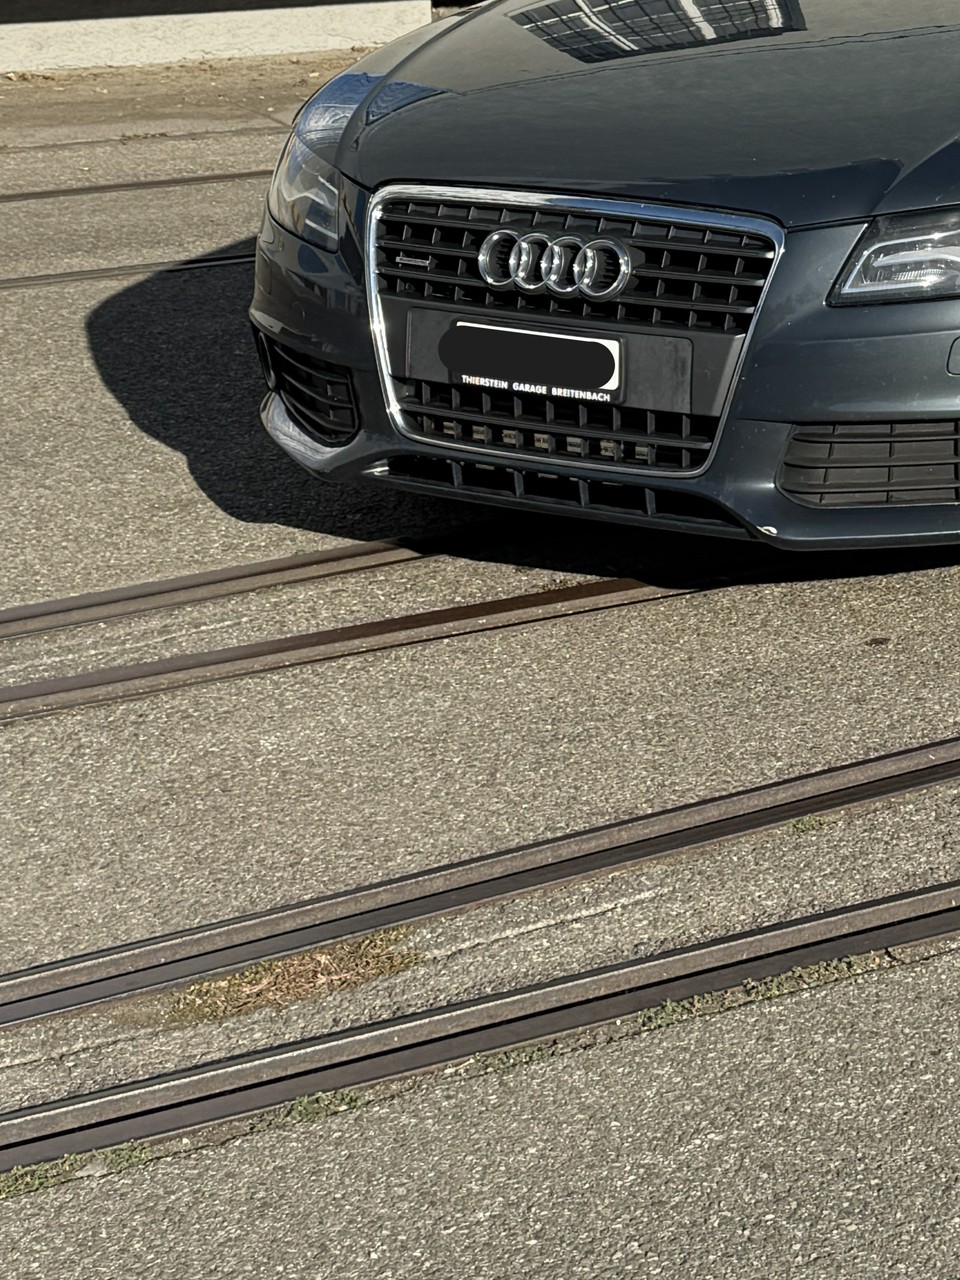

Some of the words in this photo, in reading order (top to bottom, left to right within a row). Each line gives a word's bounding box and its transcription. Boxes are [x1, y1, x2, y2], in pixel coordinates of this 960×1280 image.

[461, 374, 508, 390] THIERSTEIN
[512, 382, 547, 395] GARAGE
[551, 387, 611, 402] BREITENBACH
